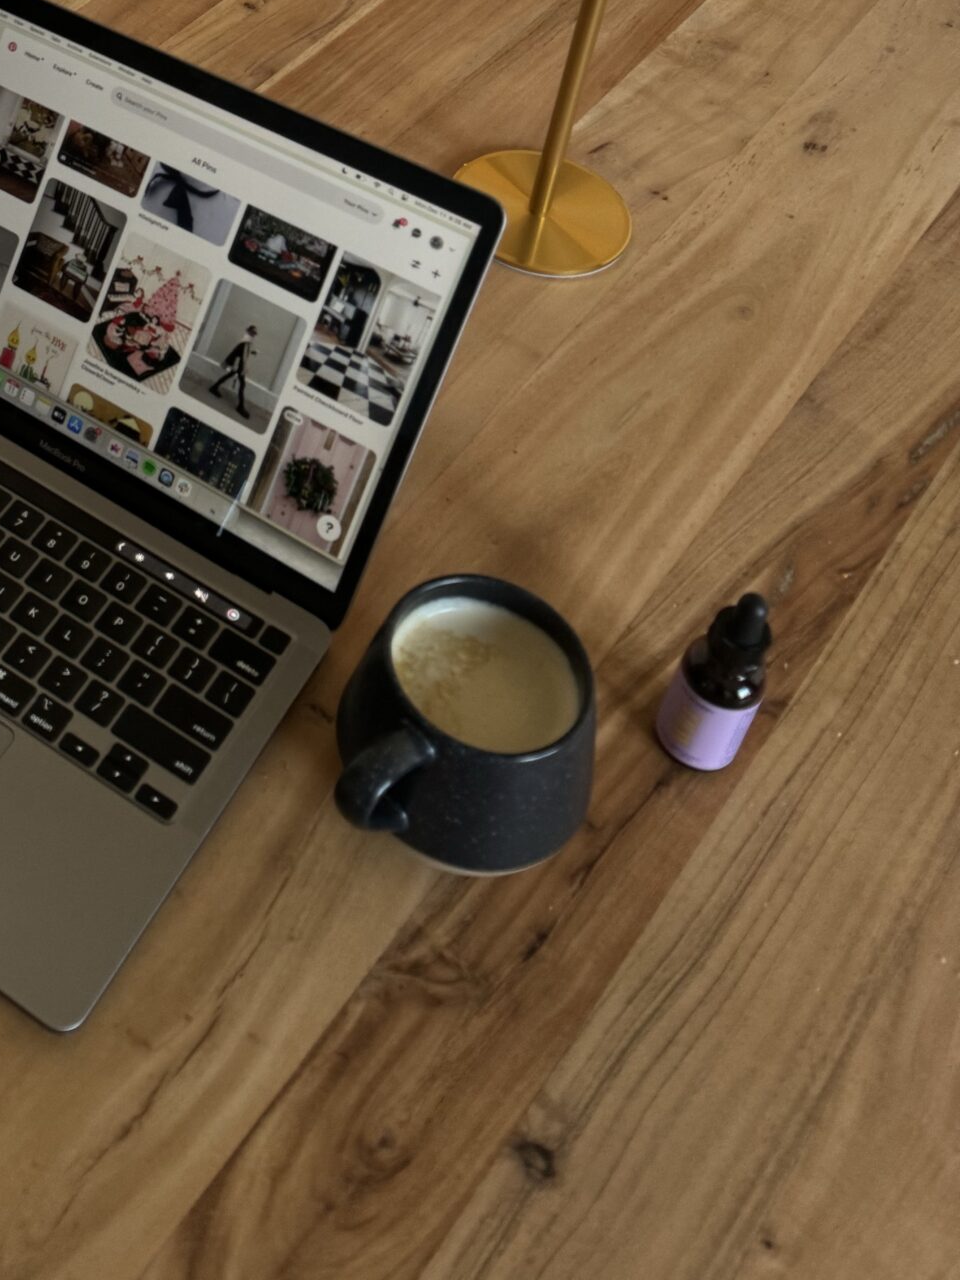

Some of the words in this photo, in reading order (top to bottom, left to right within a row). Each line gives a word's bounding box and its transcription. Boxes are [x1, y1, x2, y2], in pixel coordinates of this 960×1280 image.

[52, 63, 73, 77] Explore
[85, 78, 104, 91] Create
[191, 155, 202, 166] All
[201, 160, 217, 173] Pins
[15, 518, 24, 527] 7
[47, 539, 57, 549] 8
[10, 552, 21, 562] U
[81, 560, 91, 570] 9
[29, 608, 39, 618] K
[114, 617, 124, 626] P
[64, 630, 72, 641] L
[30, 714, 54, 732] option
